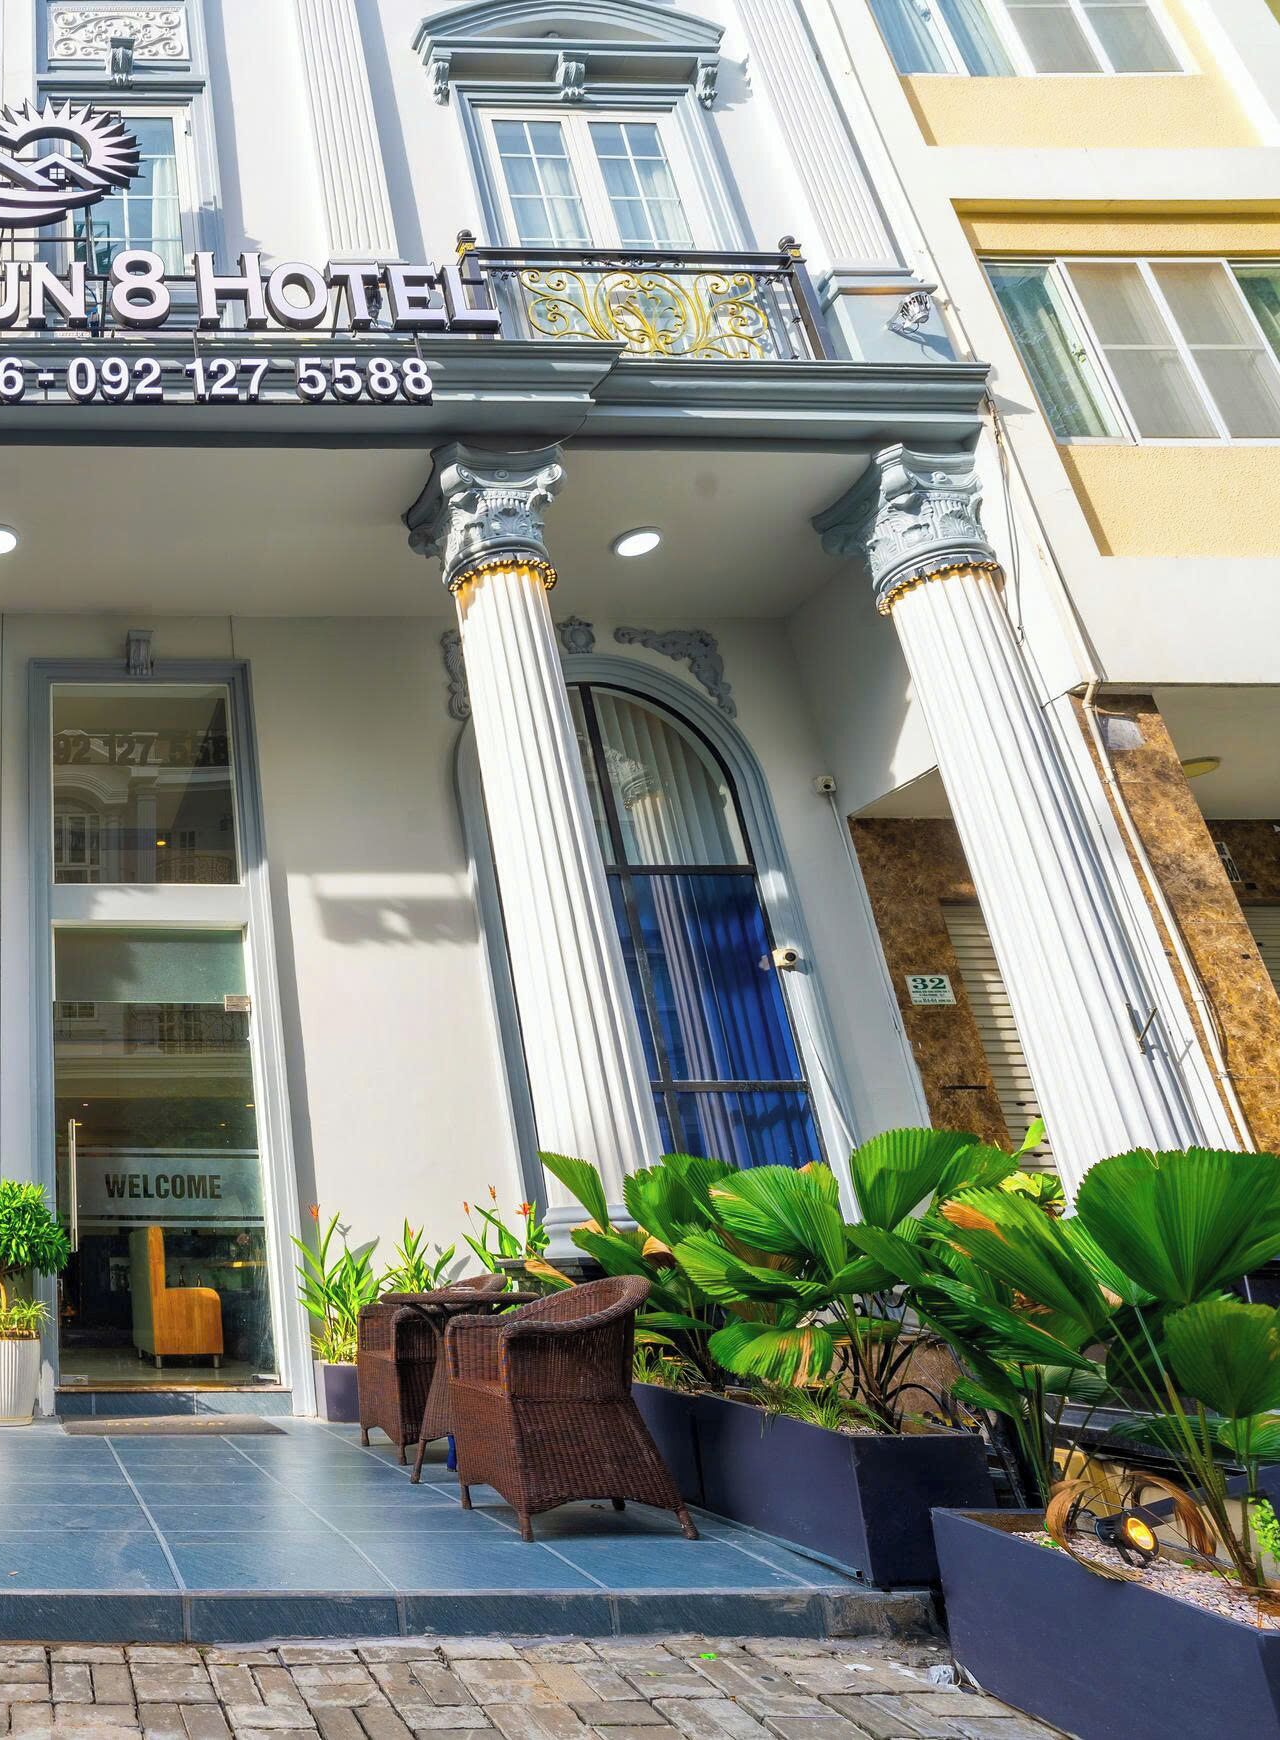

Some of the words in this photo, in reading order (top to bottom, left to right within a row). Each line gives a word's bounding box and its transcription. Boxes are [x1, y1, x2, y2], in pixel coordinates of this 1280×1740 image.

[109, 249, 170, 330] 8
[194, 250, 502, 330] HOTEL
[185, 356, 269, 402] 127
[295, 356, 434, 402] 5588
[911, 977, 947, 990] 32
[104, 1173, 223, 1199] WELCOME
